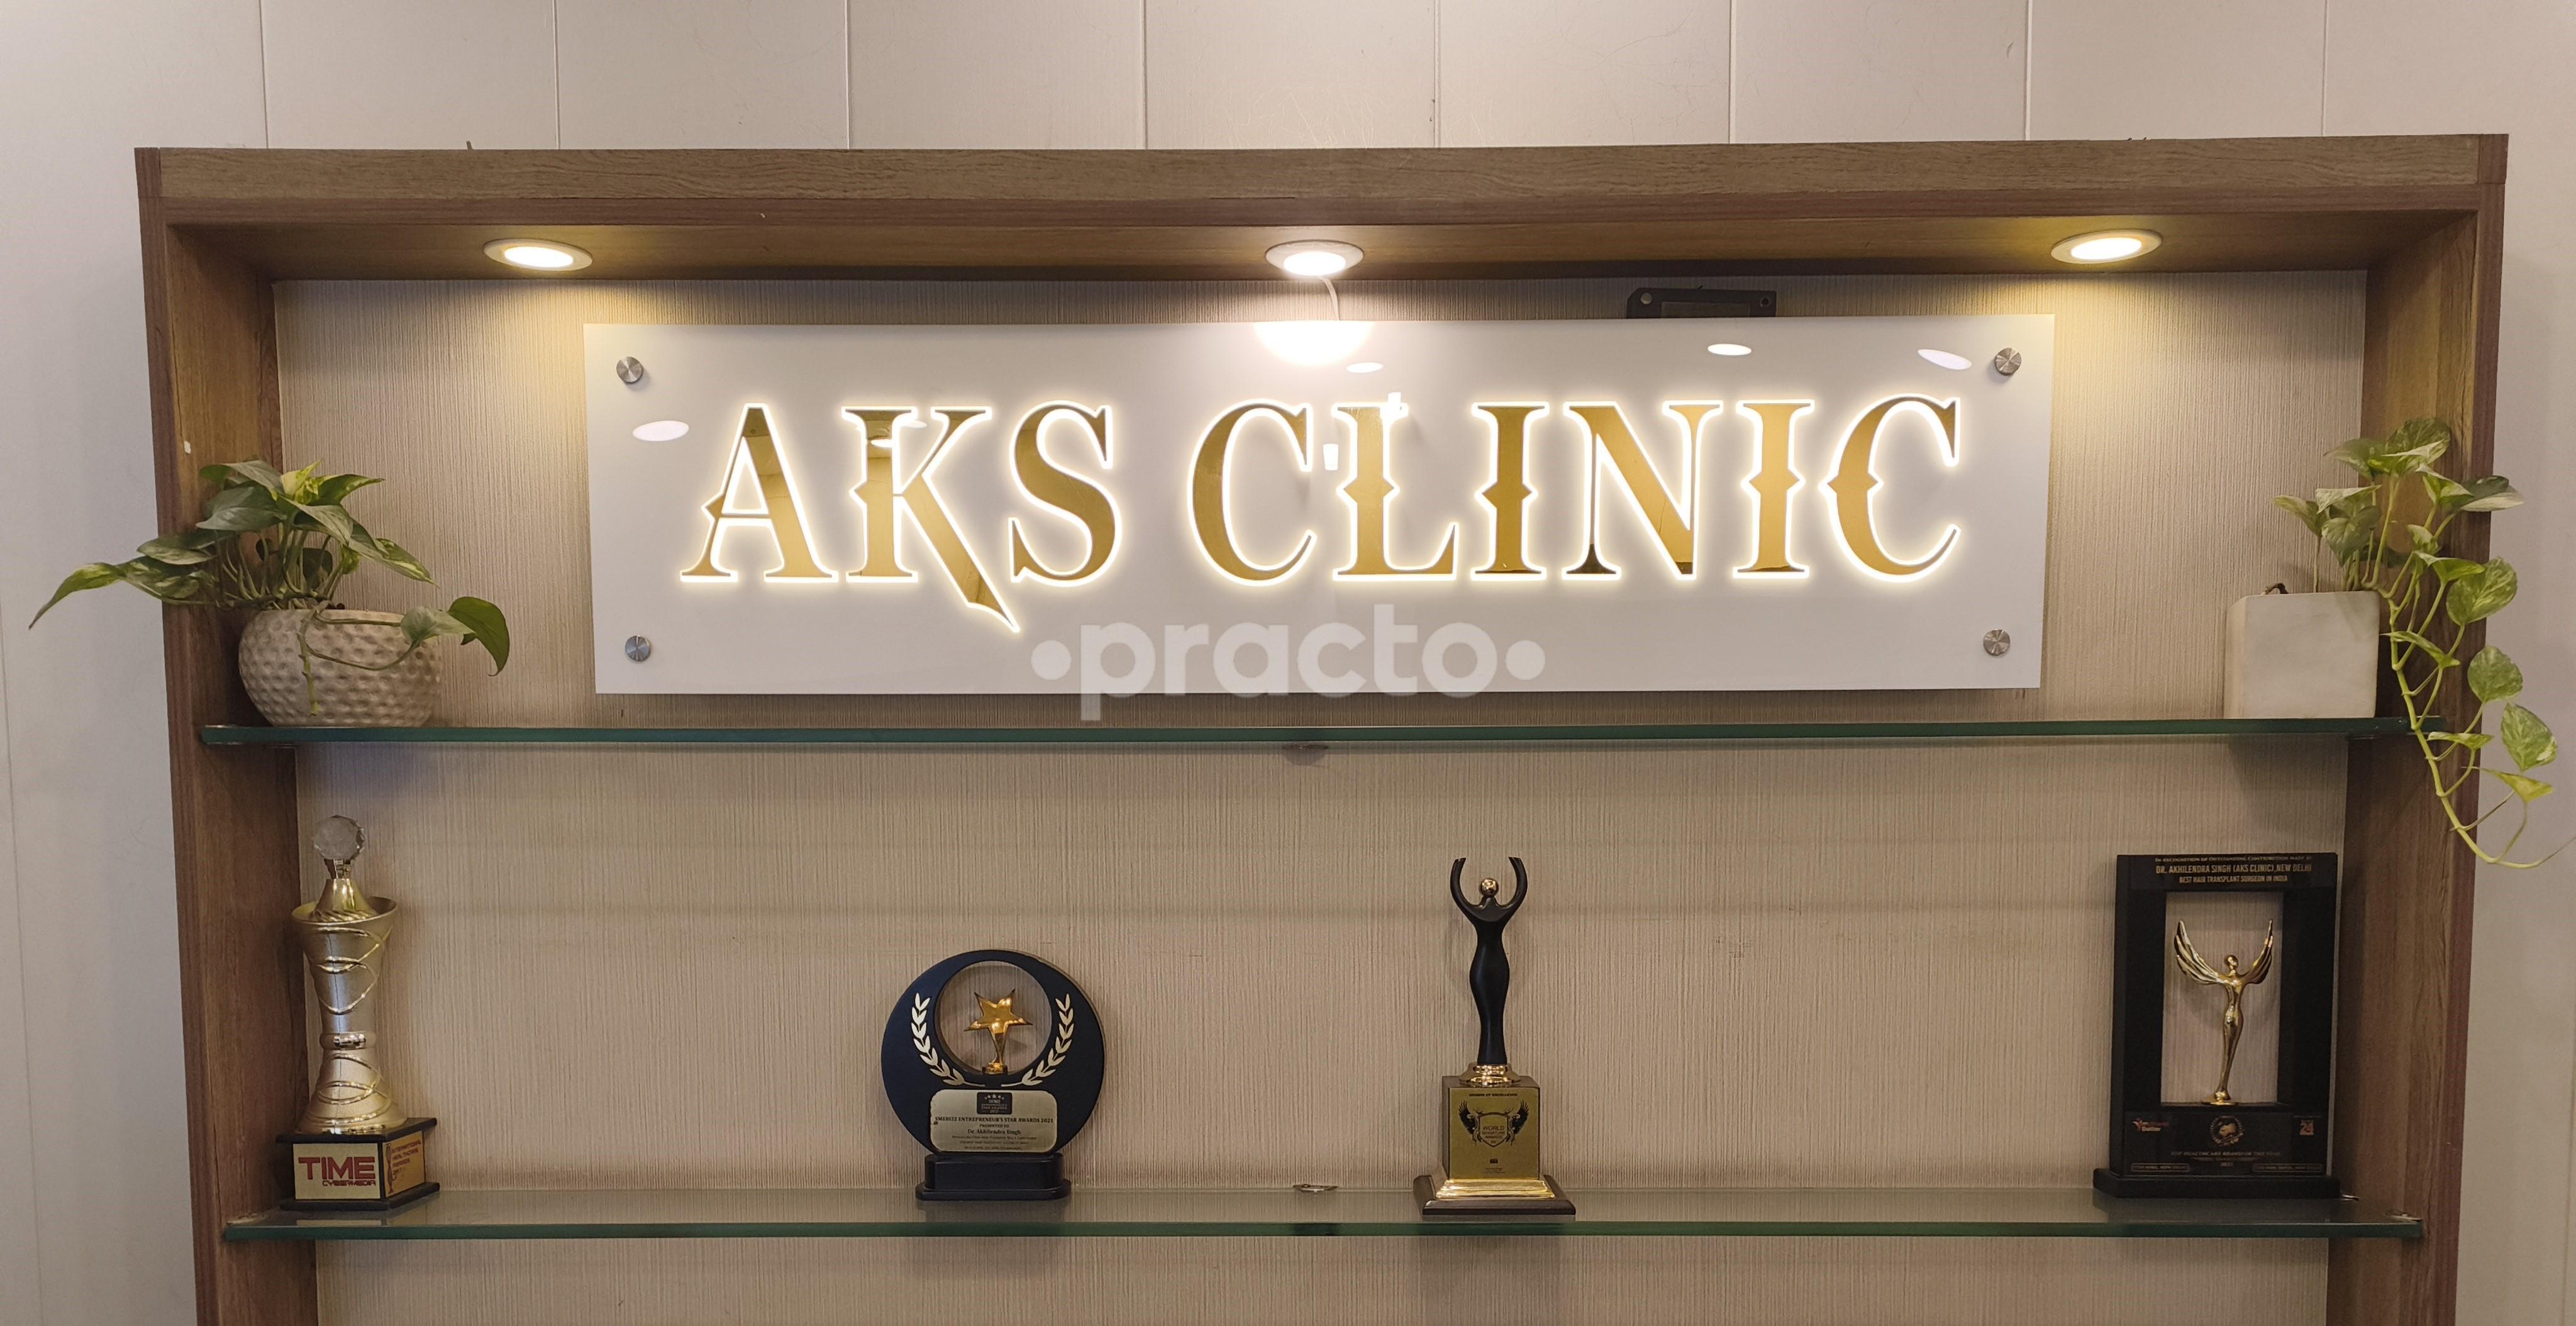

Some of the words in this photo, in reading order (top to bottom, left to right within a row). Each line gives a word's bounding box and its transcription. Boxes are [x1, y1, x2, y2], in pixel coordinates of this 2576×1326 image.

[680, 401, 1124, 631] AKS
[1189, 394, 1962, 585] CLINIC
[2155, 866, 2167, 874] DR.
[2169, 865, 2210, 874] AKHILENDRA
[2211, 864, 2231, 873] SINGH
[2233, 864, 2250, 873] (AKS
[2292, 864, 2312, 872] DELHI
[298, 1156, 376, 1180] TIME
